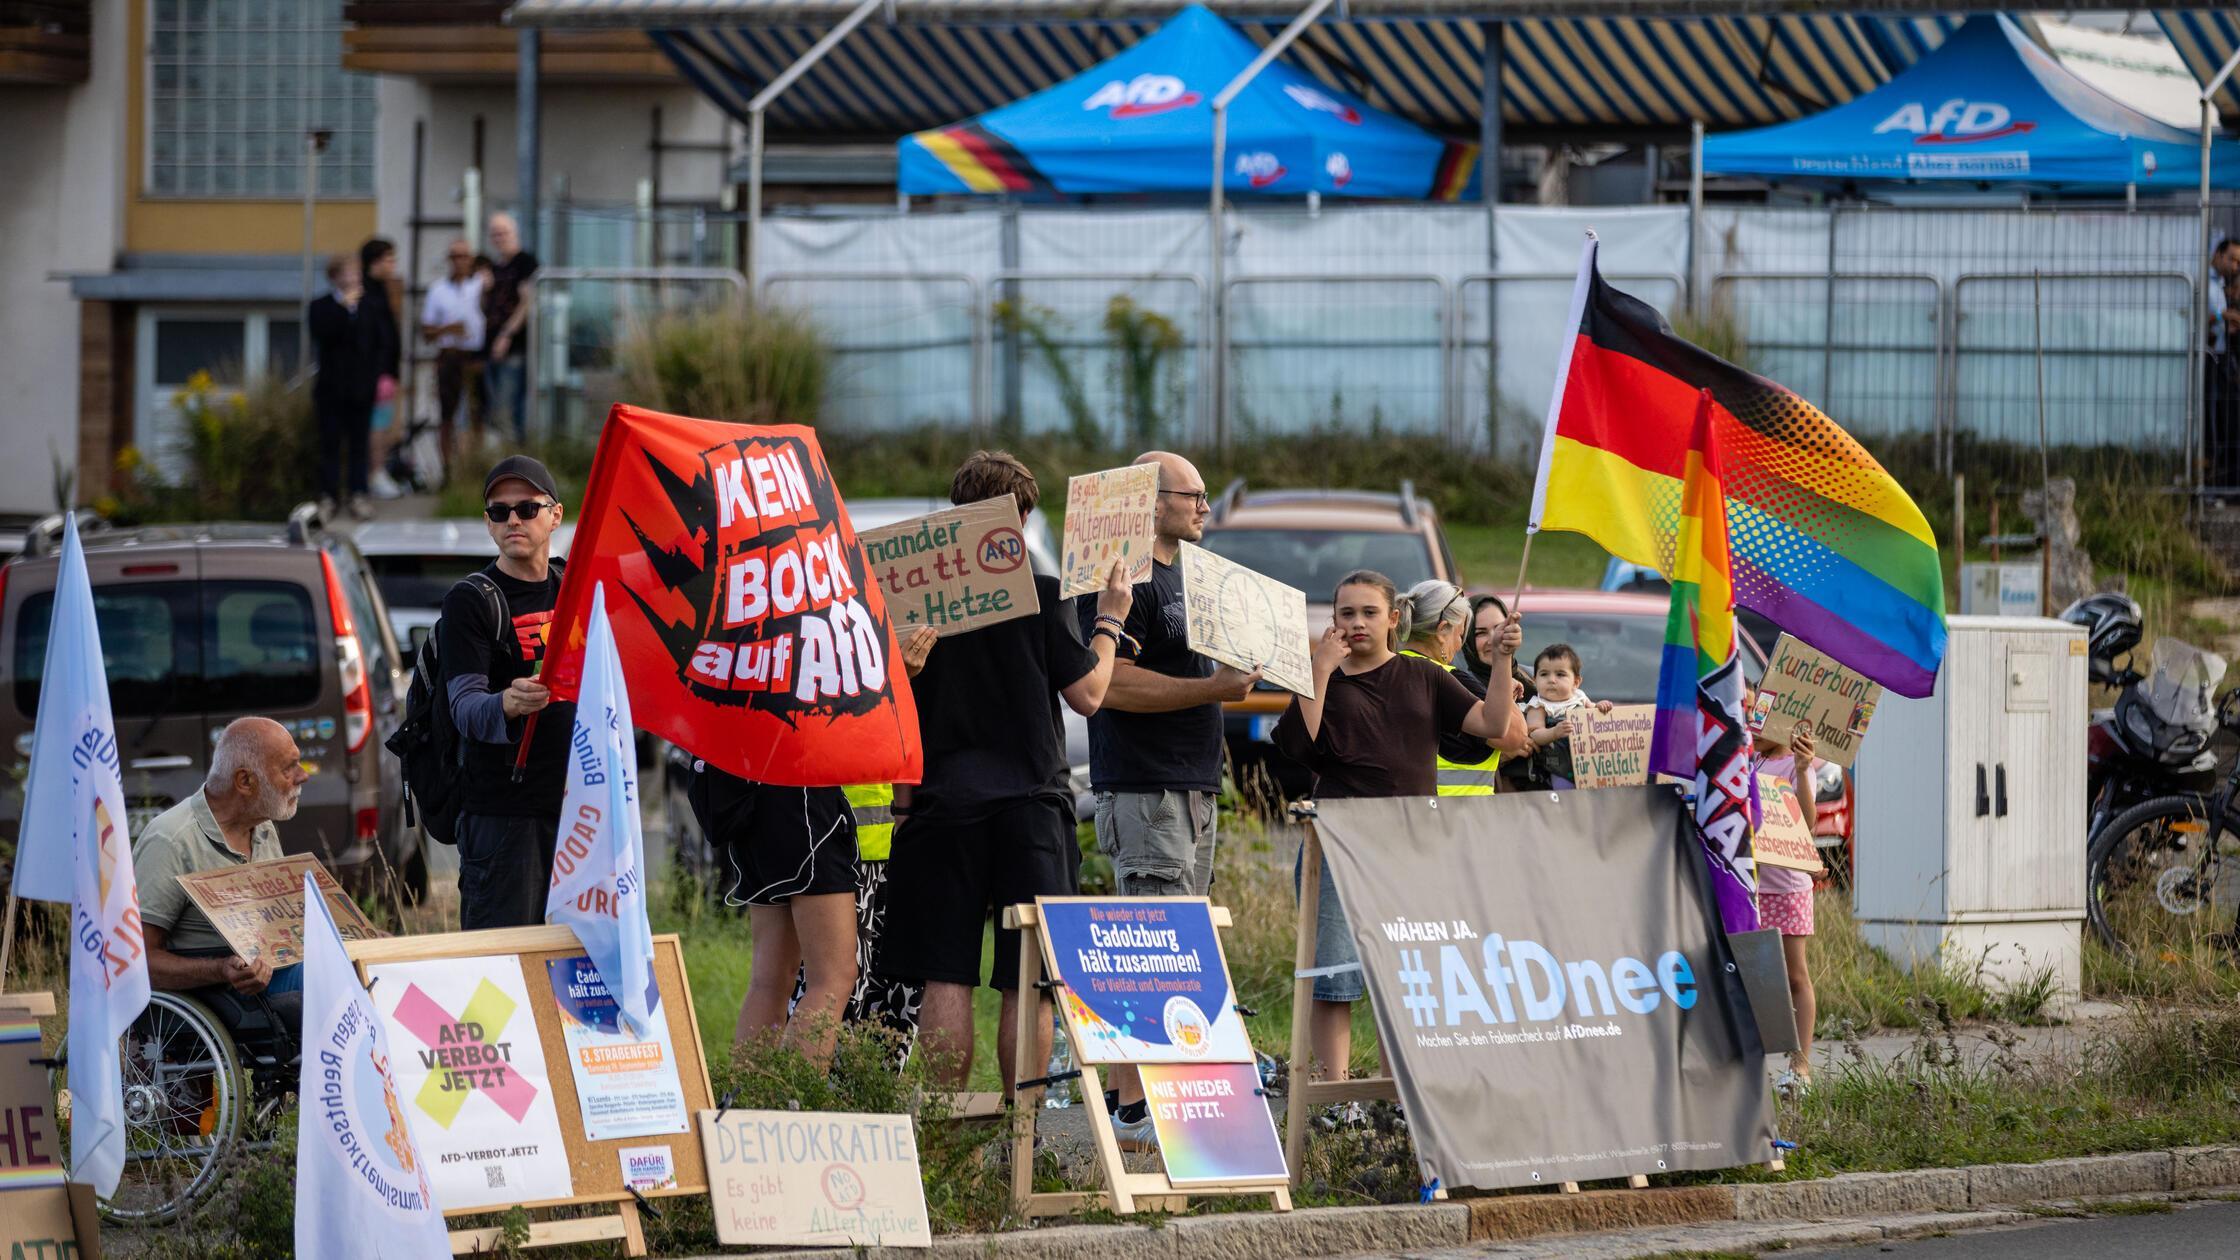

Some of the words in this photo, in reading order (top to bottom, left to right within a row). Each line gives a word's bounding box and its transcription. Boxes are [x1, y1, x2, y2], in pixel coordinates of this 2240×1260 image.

[1873, 99, 2011, 134] AfD
[716, 448, 811, 528] KEIN
[1070, 500, 1152, 545] Alternativen
[859, 519, 963, 566] nander
[984, 536, 1021, 563] AfD
[726, 532, 853, 624] BOCK
[1076, 562, 1097, 585] zur
[924, 584, 1014, 627] Hetze
[692, 636, 792, 683] auf
[796, 594, 885, 703] AfD
[1775, 643, 1873, 702] kunterbunt
[1772, 689, 1816, 720] statt
[1586, 711, 1653, 735] Menschenwürde
[1815, 709, 1852, 752] braun
[1589, 731, 1645, 755] Demokratie
[1591, 751, 1641, 777] Vielfalt
[1089, 907, 1105, 921] Nie
[1106, 908, 1134, 922] wieder
[1135, 908, 1147, 921] ist
[1147, 909, 1168, 924] jetzt
[1089, 923, 1180, 952] Cadolzburg
[1382, 917, 1450, 942] WÄHLEN
[1452, 919, 1479, 940] JA.
[1077, 948, 1114, 973] hält
[1112, 948, 1202, 973] zusammen!
[568, 984, 590, 999] hält
[1091, 977, 1107, 992] Für
[1107, 978, 1139, 992] Vielfalt
[1139, 978, 1155, 992] und
[1153, 977, 1202, 992] Demokratie
[1398, 932, 1698, 1028] #AfDnee
[440, 1022, 485, 1045] AFD
[1416, 1033, 1453, 1049] Machen
[1453, 1031, 1470, 1047] Sie
[1471, 1030, 1490, 1046] den
[1490, 1026, 1545, 1045] Faktencheck
[1545, 1024, 1563, 1042] auf
[1562, 1021, 1623, 1040] AfDnee.de
[417, 1042, 512, 1070] VERBOT
[439, 1067, 506, 1092] JETZT
[1150, 1081, 1178, 1099] NIE
[1177, 1078, 1235, 1098] WIEDER
[1157, 1102, 1179, 1121] IST
[1180, 1101, 1225, 1123] JETZT.
[441, 1145, 539, 1164] AFD-VERBOT.JETZT
[716, 1121, 912, 1165] DEMOKRATIE
[630, 1153, 665, 1168] DAFÜR!
[727, 1177, 745, 1199] Es
[750, 1175, 786, 1204] gibt
[731, 1206, 778, 1233] keine
